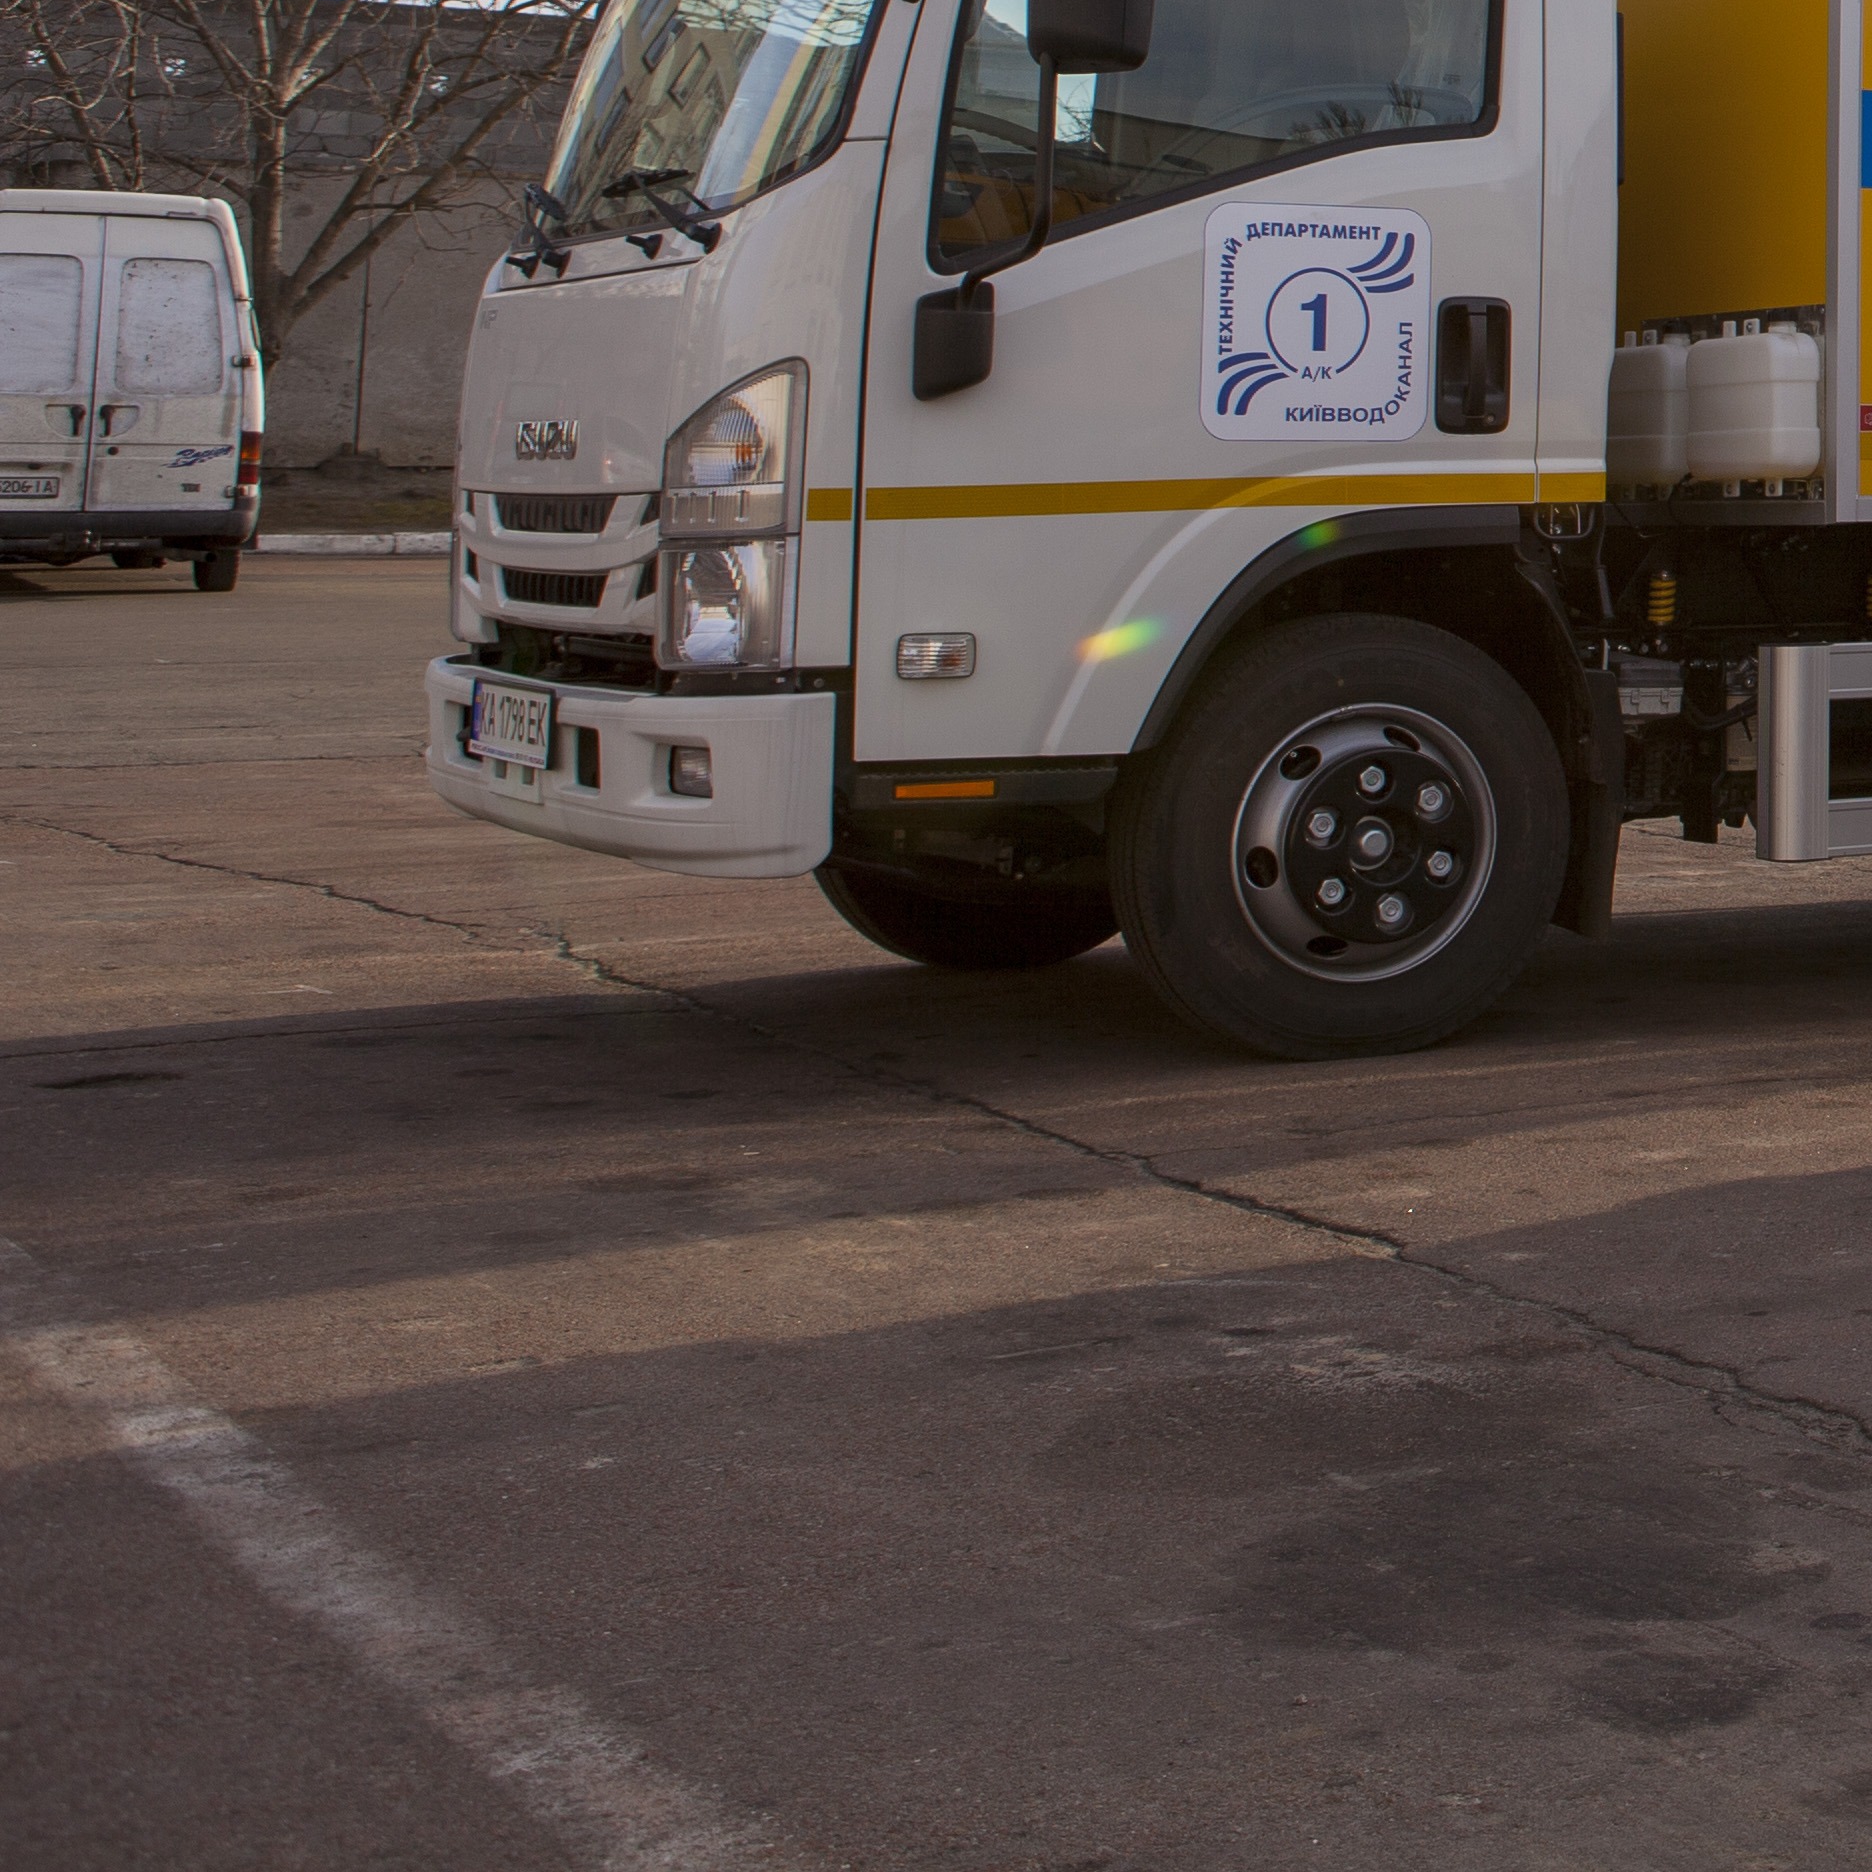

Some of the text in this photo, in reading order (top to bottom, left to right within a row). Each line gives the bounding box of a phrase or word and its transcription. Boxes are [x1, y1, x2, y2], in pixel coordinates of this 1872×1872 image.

[1246, 221, 1381, 241] ДЕПАРТАМЕНТ
[1218, 237, 1243, 356] ТЕХНІЧНИЙ
[1300, 293, 1328, 352] 1
[1285, 321, 1413, 425] КИЇВВОДОКАНАЛ
